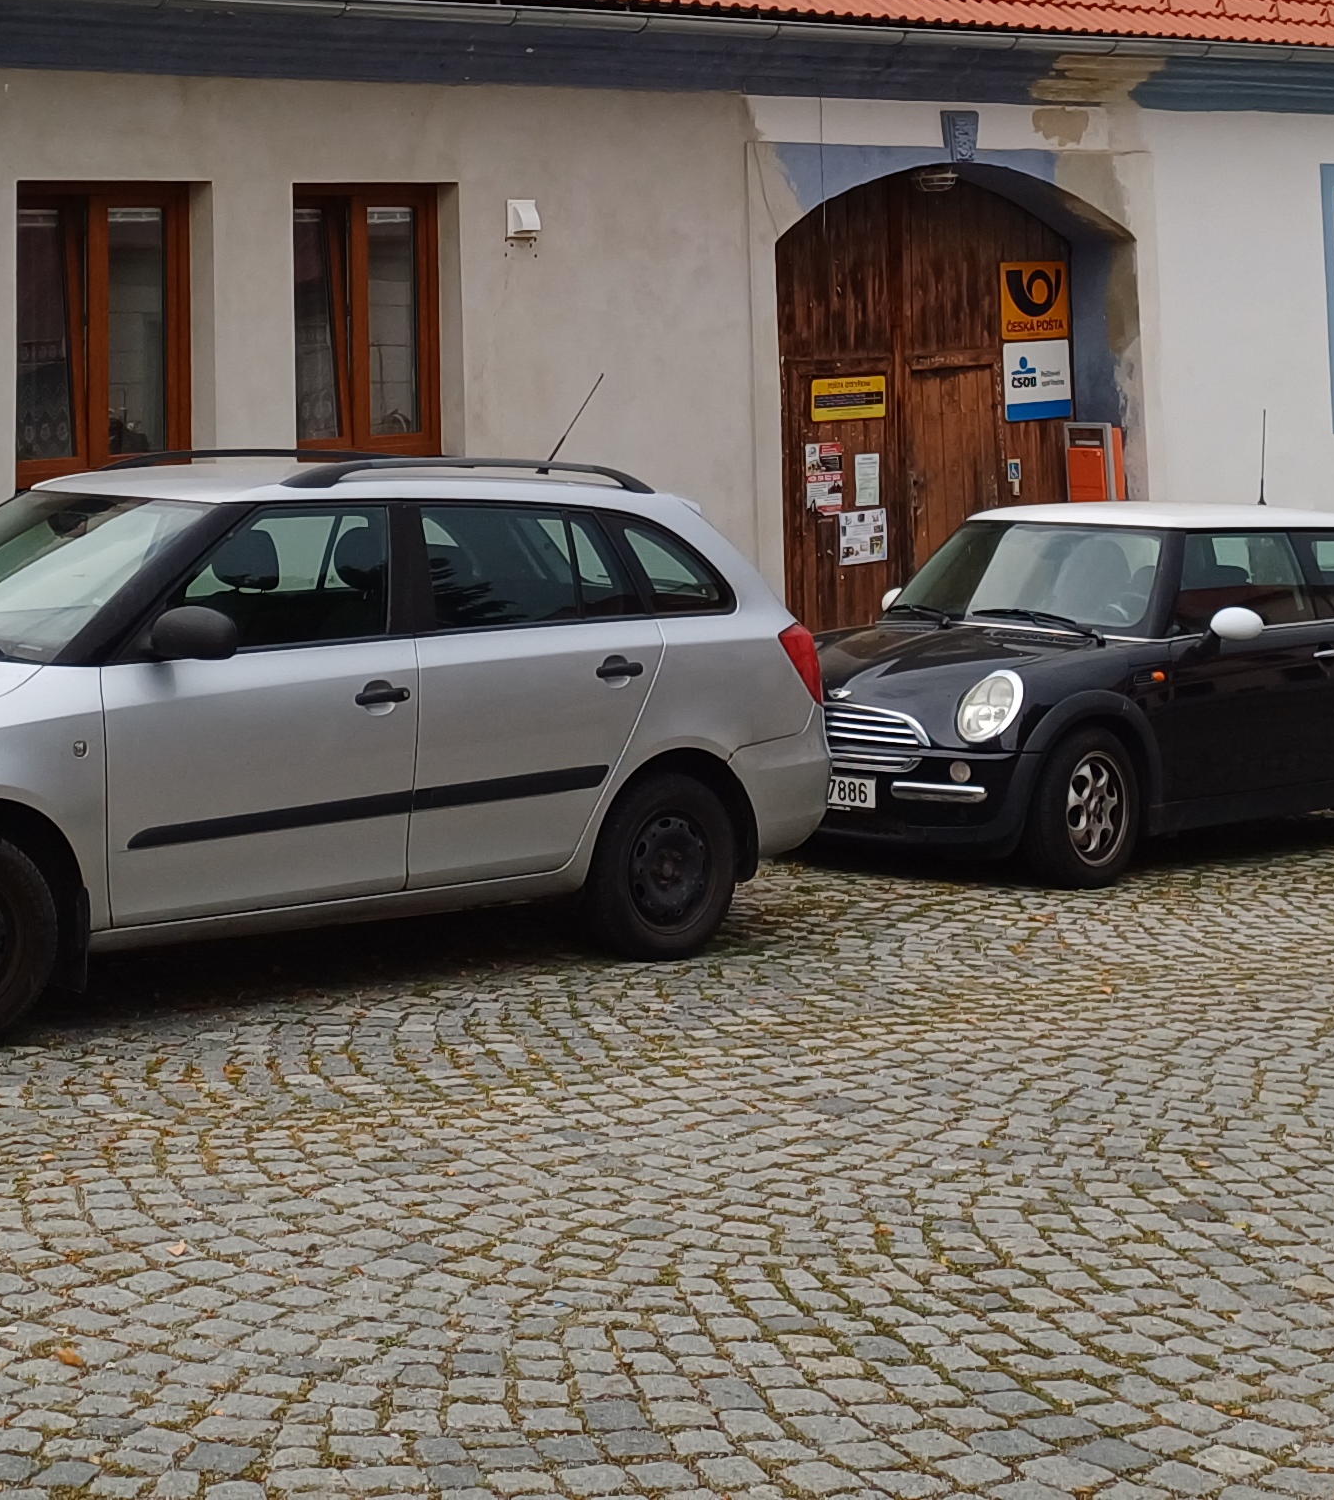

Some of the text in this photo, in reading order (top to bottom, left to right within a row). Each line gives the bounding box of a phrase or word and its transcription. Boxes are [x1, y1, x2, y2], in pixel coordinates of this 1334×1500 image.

[1006, 317, 1064, 333] ČESKÁ POŠTA
[828, 779, 868, 804] 7886
